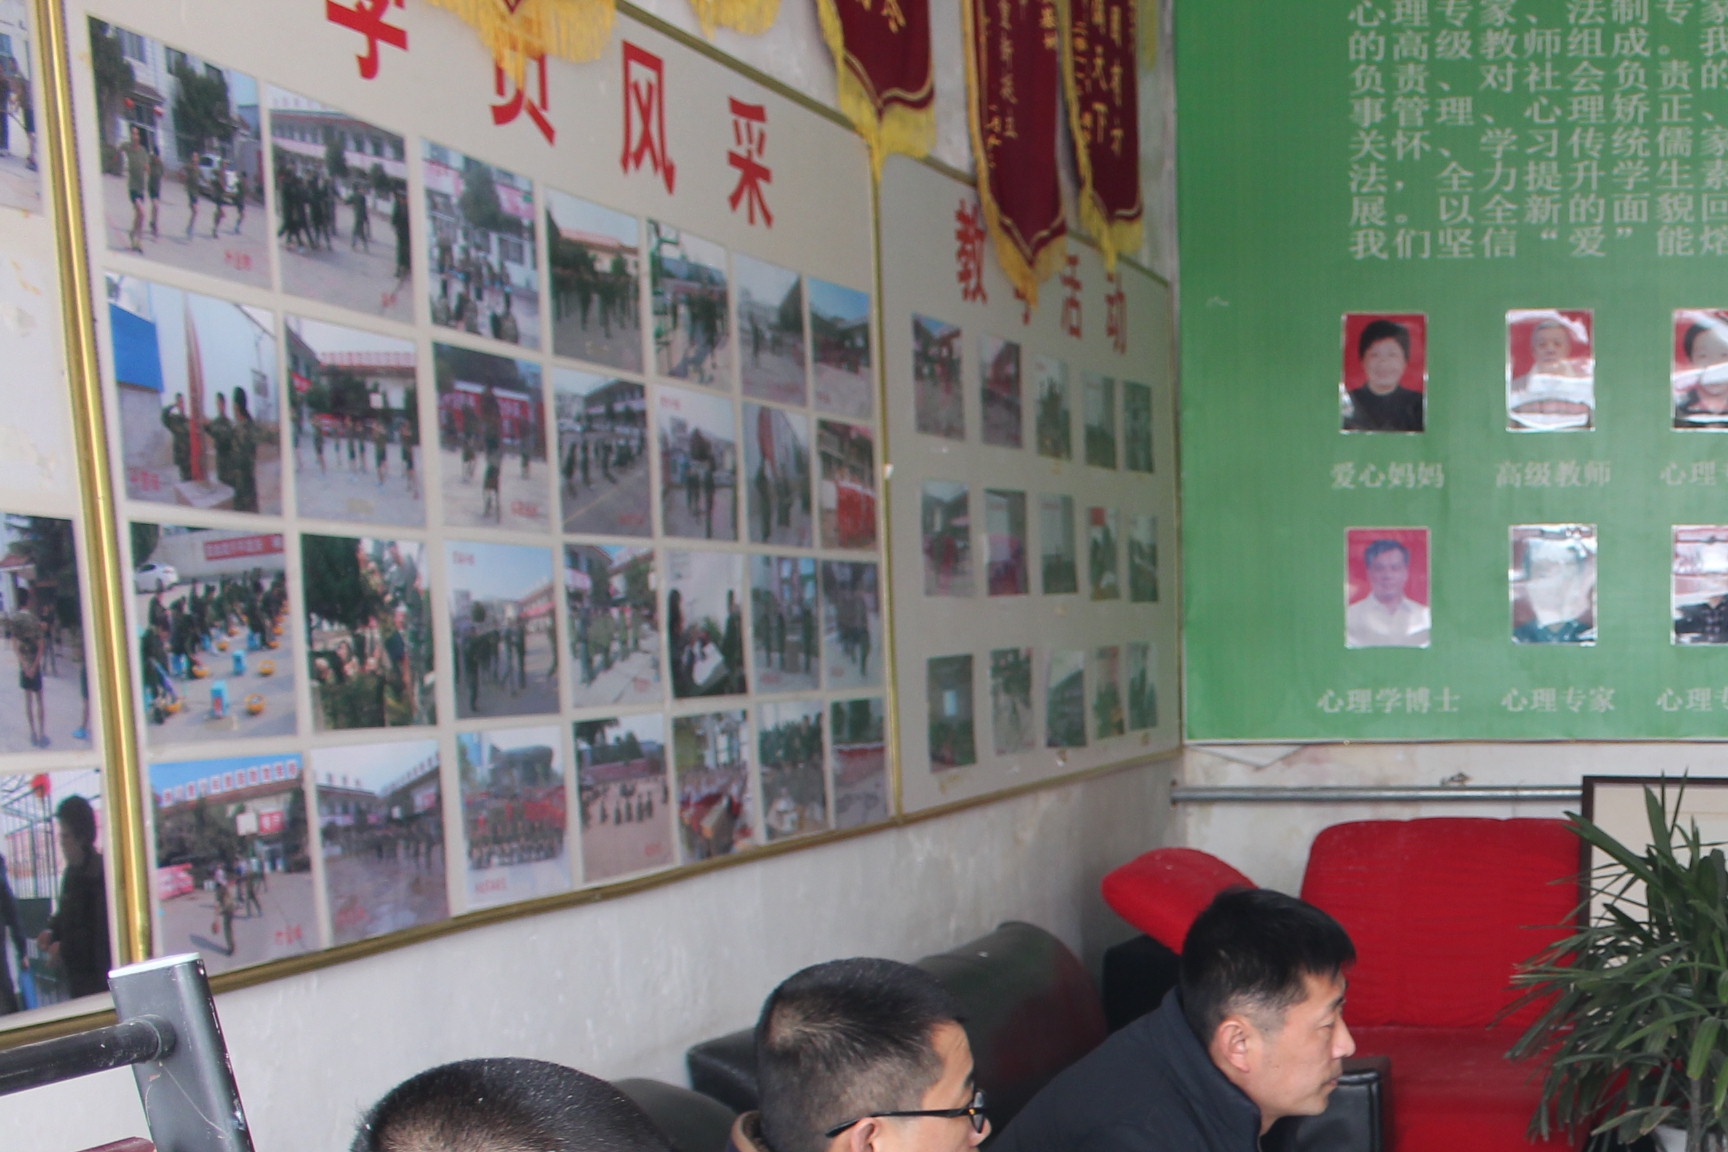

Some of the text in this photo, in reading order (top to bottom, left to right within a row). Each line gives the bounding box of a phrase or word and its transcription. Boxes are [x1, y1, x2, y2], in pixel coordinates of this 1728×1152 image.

[1330, 461, 1445, 490] 爱心妈妈
[1496, 460, 1611, 489] 高级教师
[1317, 687, 1461, 714] 心理学博士
[1500, 687, 1616, 713] 心理专家
